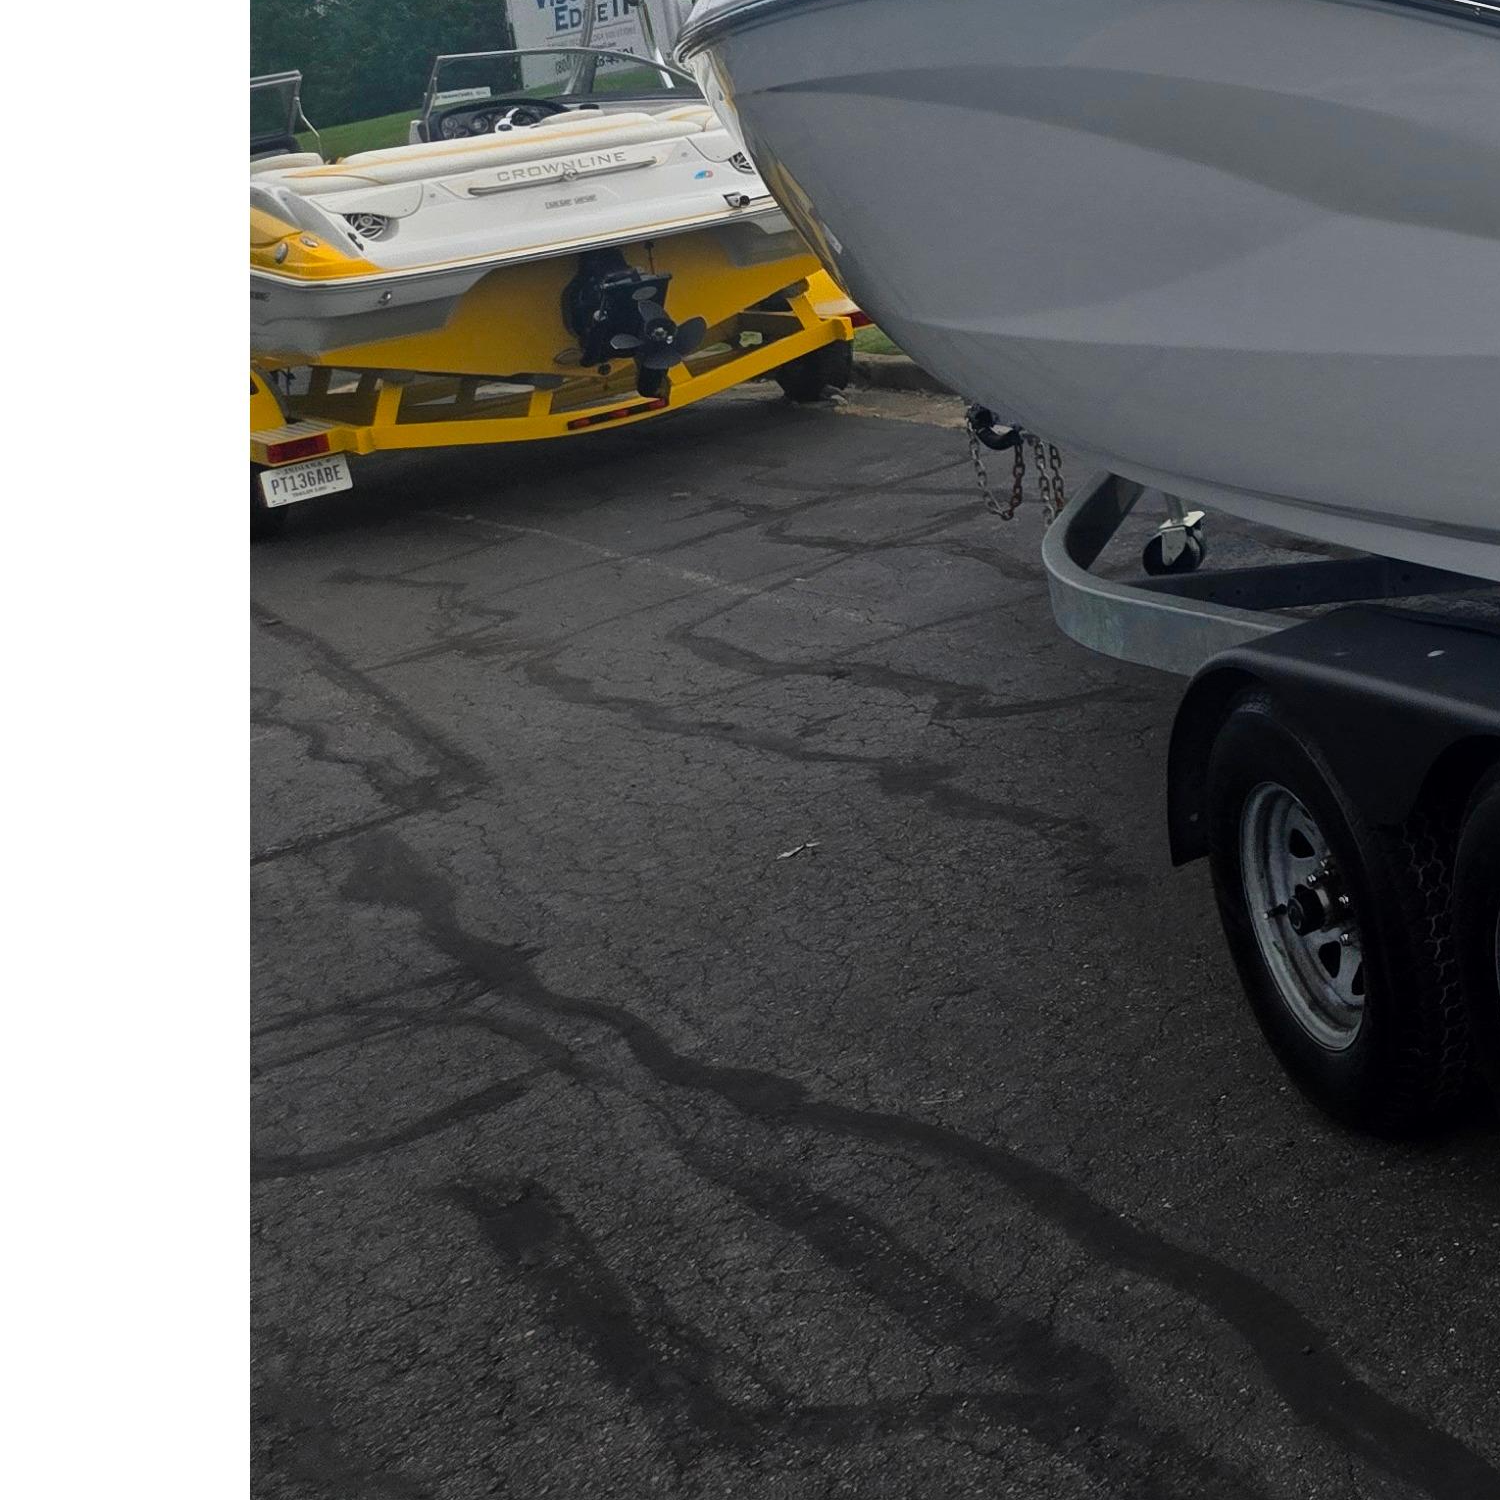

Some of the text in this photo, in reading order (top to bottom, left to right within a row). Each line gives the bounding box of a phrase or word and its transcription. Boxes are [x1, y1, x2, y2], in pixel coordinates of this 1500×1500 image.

[554, 3, 608, 31] EDE
[497, 152, 626, 182] CROWNLINE
[271, 464, 344, 495] PT136ABE
